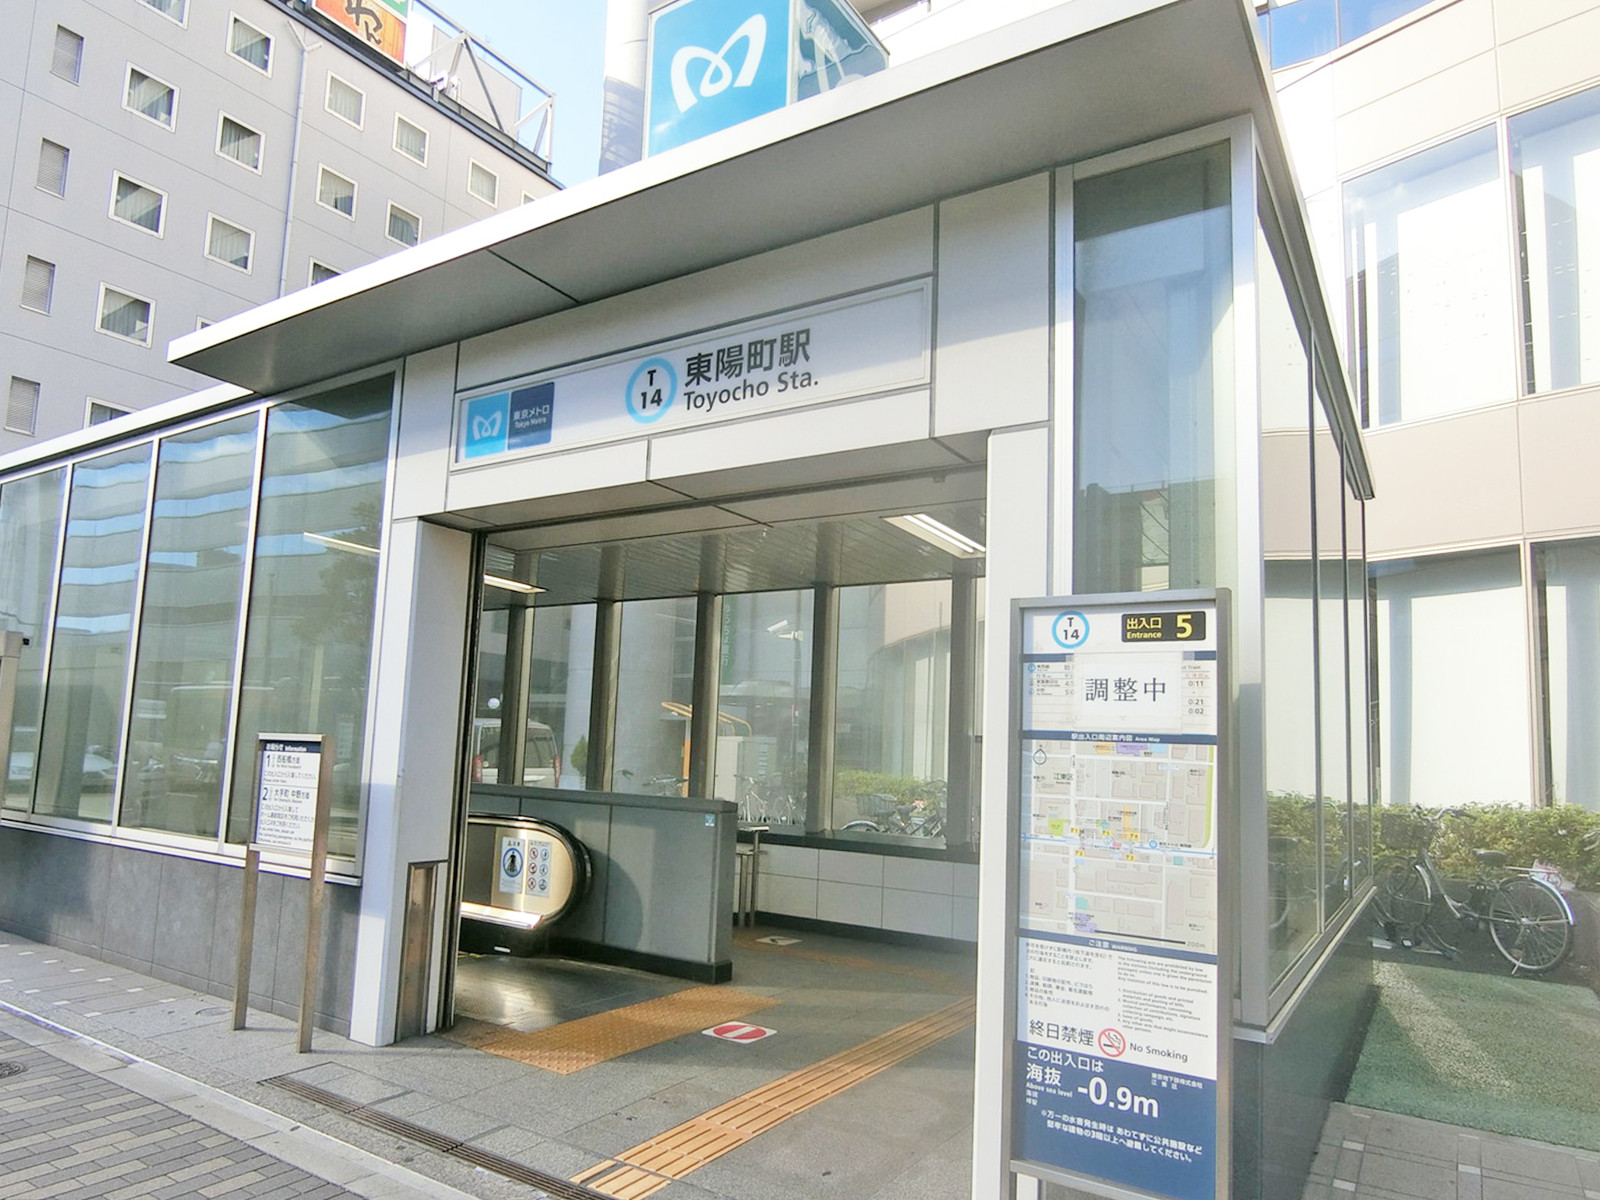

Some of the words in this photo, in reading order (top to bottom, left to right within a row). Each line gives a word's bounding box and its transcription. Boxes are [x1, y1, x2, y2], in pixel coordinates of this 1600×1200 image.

[685, 329, 810, 386] 東陽町駅
[647, 369, 656, 386] T
[640, 388, 663, 410] 14
[684, 378, 769, 412] Toyocho
[777, 371, 818, 393] Sta.
[514, 405, 549, 421] 東京メトロ
[515, 420, 530, 428] Tokyo
[531, 417, 547, 425] Metro
[1067, 617, 1073, 627] T
[1127, 617, 1162, 629] 出入口
[1176, 615, 1193, 638] 5
[1063, 630, 1079, 640] 14
[1127, 631, 1162, 639] Entrance
[1085, 677, 1166, 703] 調整中
[266, 755, 270, 768] 1
[263, 787, 267, 800] 2
[1088, 939, 1110, 948] ご注意
[1029, 1018, 1094, 1046] 終日禁煙
[1027, 1046, 1103, 1073] この出入口は
[1129, 1042, 1142, 1052] No
[1146, 1044, 1187, 1063] Smoking
[1026, 1063, 1061, 1086] 海抜
[1078, 1077, 1159, 1118] -0.9m
